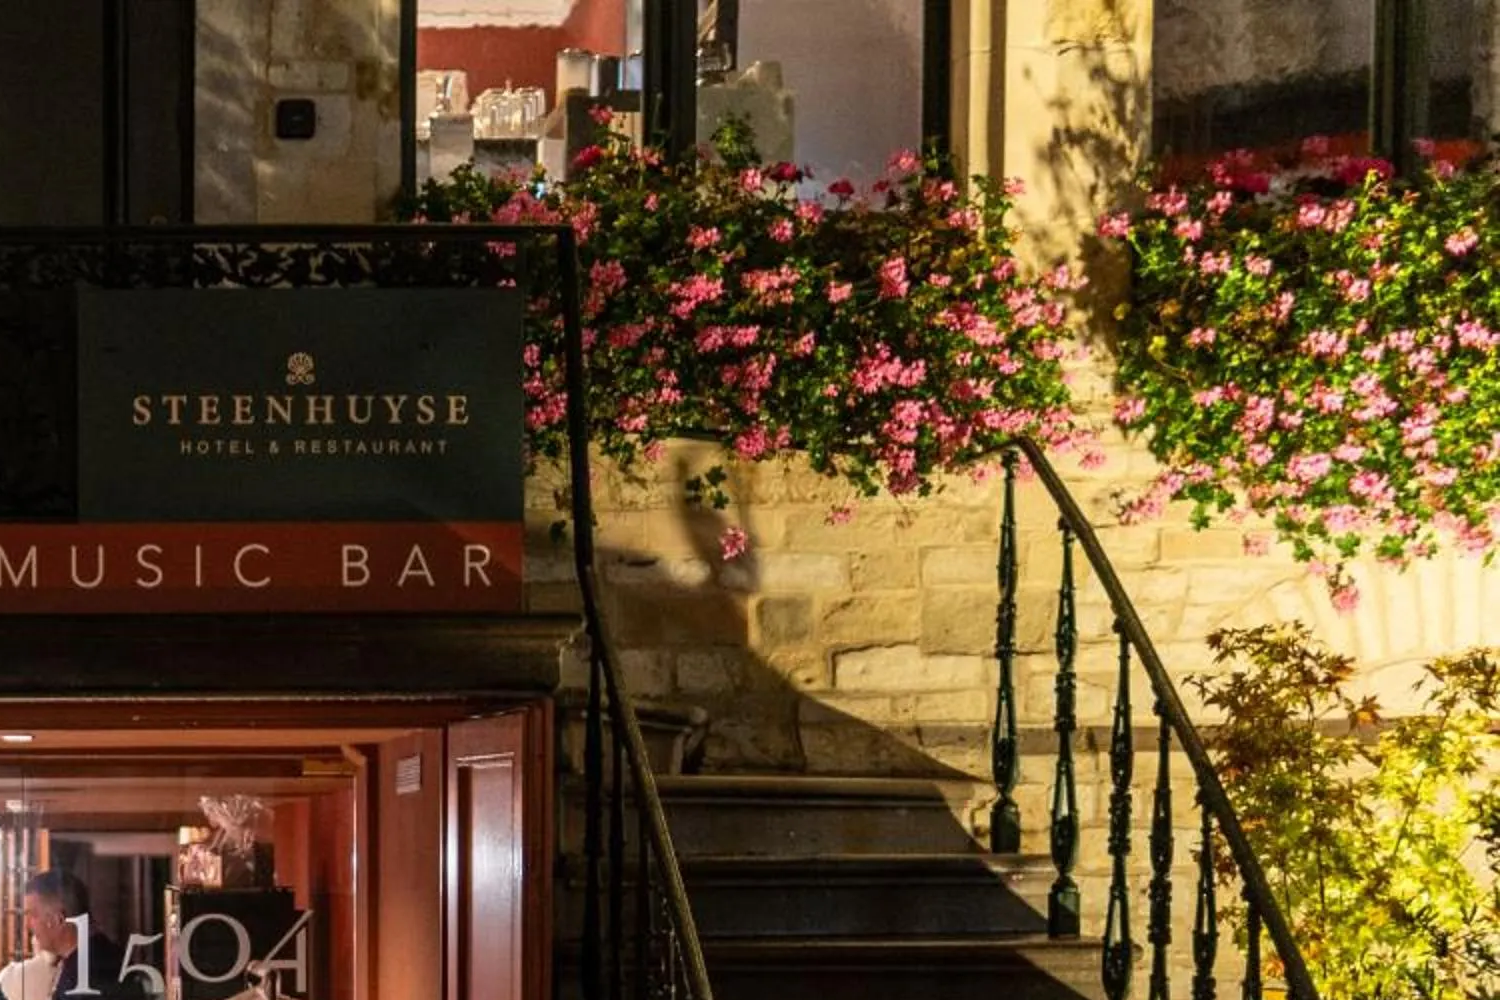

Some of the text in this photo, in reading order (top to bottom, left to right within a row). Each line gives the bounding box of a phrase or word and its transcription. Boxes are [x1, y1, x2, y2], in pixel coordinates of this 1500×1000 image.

[132, 395, 470, 425] STEENHUYSE
[180, 440, 450, 455] HOTEL & RESTAURANT
[341, 544, 493, 588] BAR
[64, 908, 315, 995] 1504
